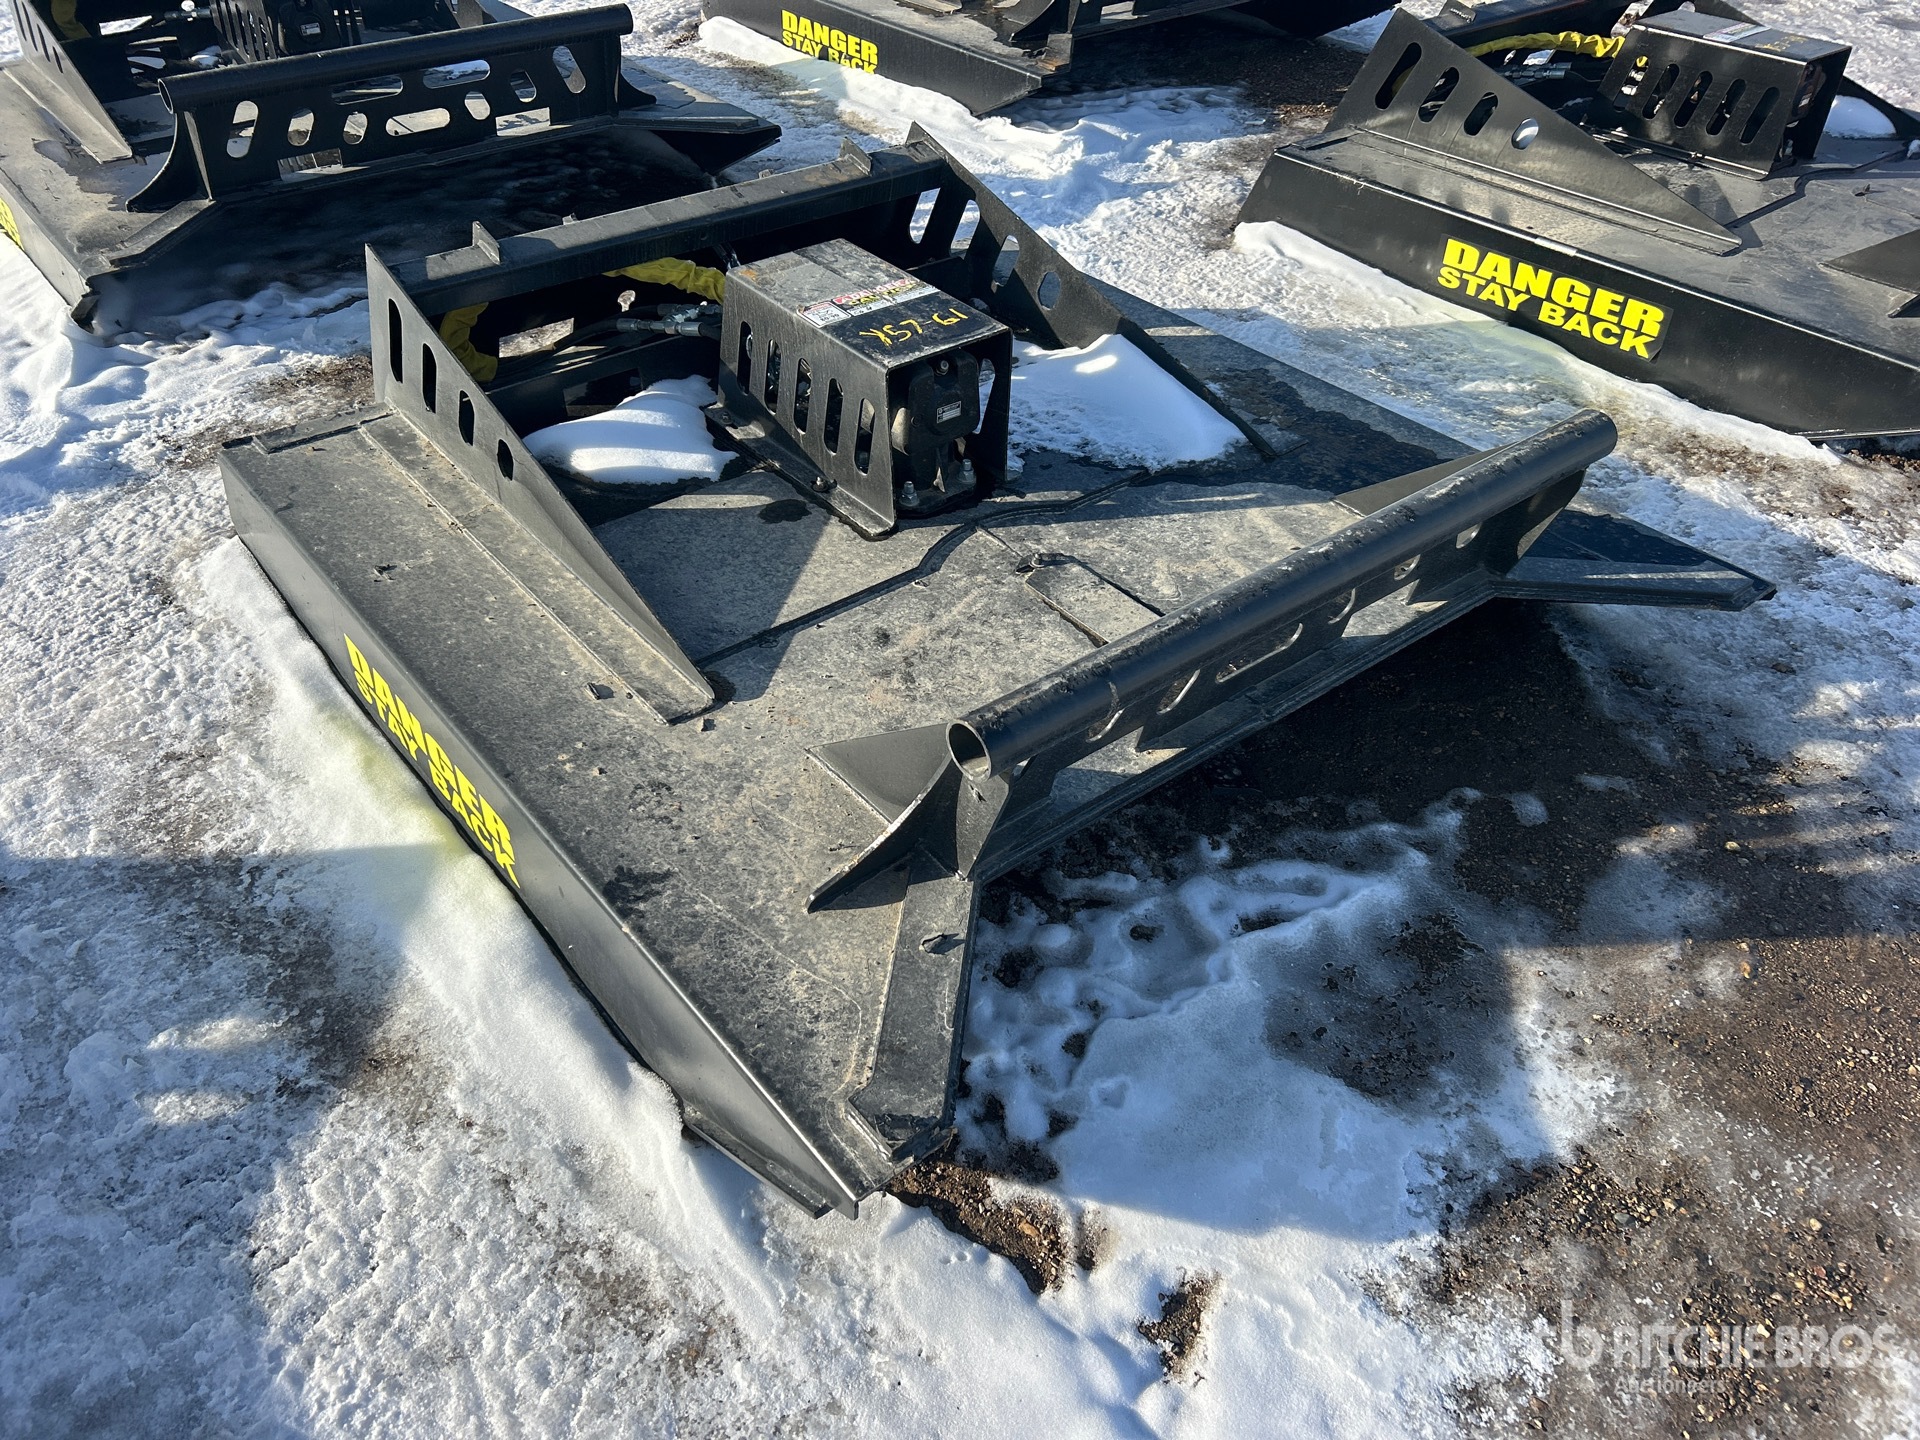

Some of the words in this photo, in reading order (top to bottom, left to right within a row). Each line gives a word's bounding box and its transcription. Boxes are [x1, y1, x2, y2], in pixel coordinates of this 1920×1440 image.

[782, 9, 878, 65] DANGER
[782, 30, 823, 58] STAY
[1437, 266, 1531, 312] STAY
[1537, 301, 1655, 359] BACK
[1442, 238, 1664, 337] DANGER
[344, 633, 515, 865] DANGER
[354, 671, 418, 761] STAY
[428, 759, 521, 889] BACK
